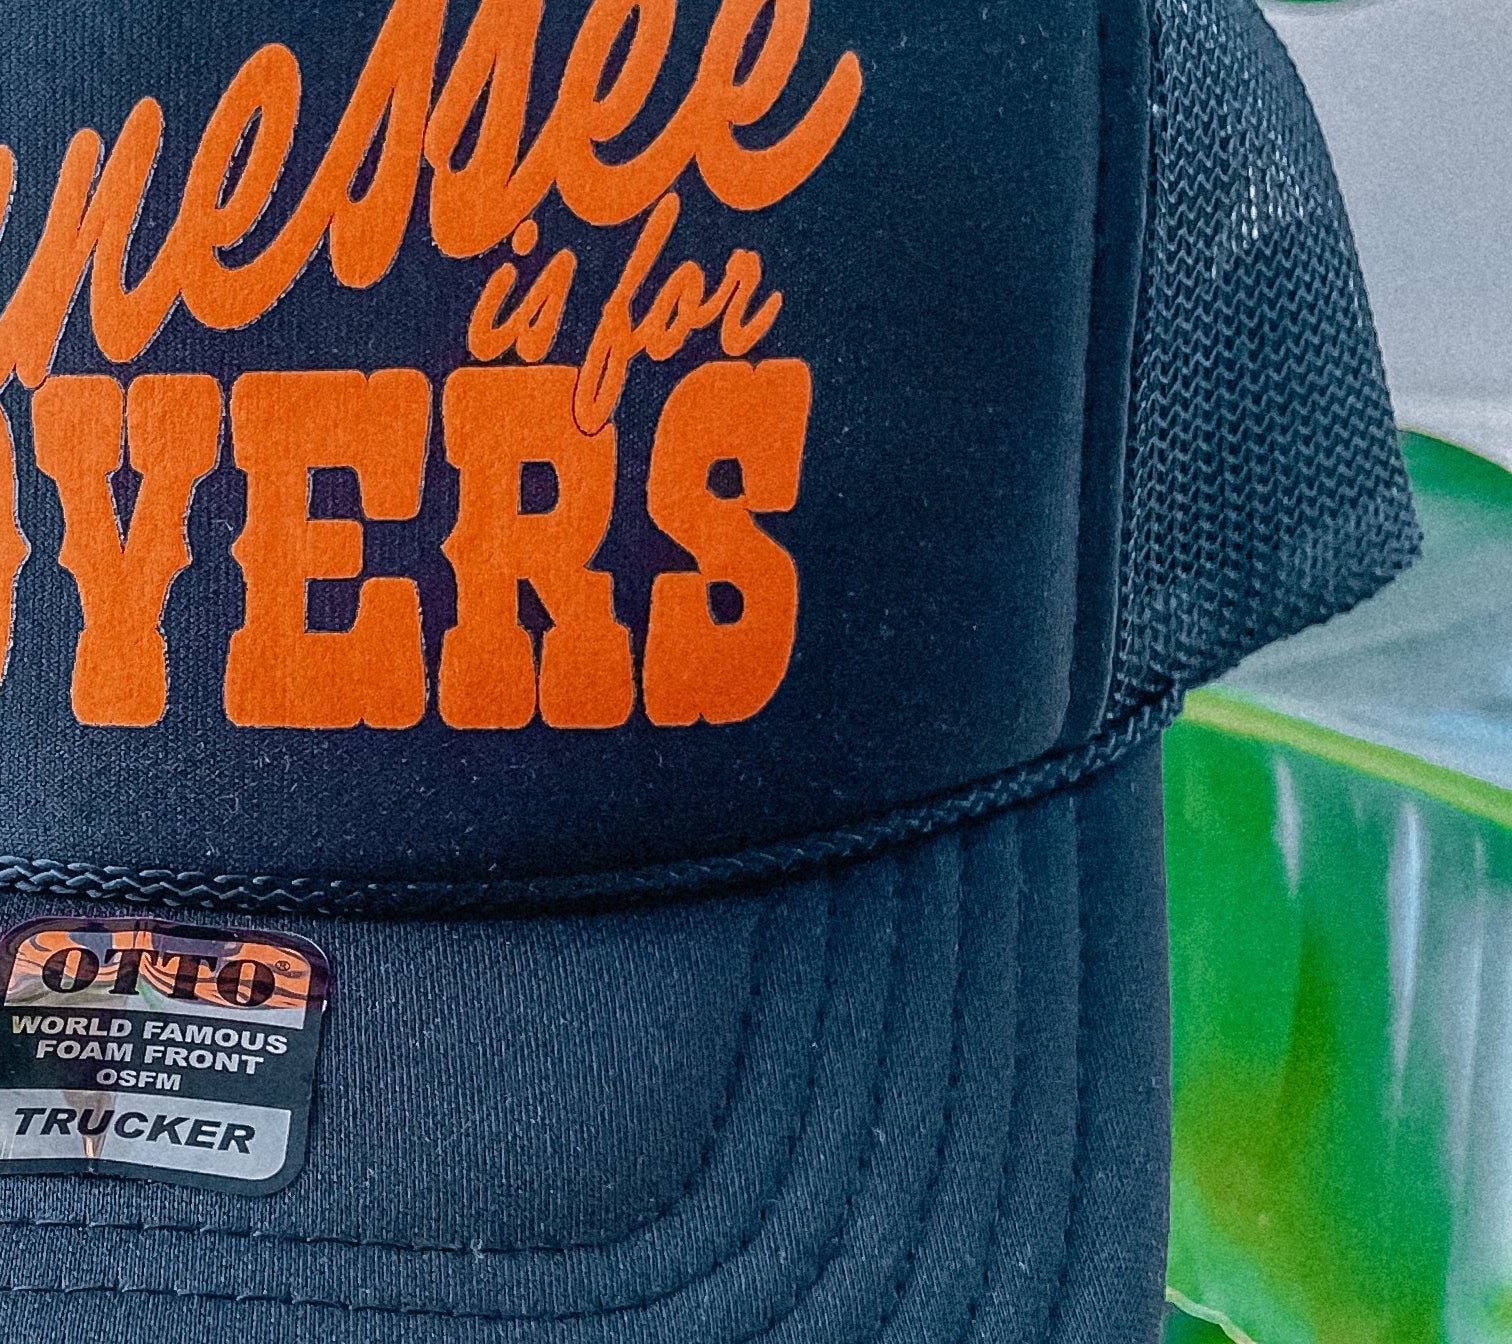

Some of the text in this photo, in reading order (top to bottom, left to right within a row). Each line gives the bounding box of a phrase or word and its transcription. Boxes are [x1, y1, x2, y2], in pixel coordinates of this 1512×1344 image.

[468, 192, 783, 437] is for
[11, 1015, 288, 1054] WORLD FAMOUS
[35, 1040, 264, 1074] FOAM FRONT
[96, 1068, 181, 1091] OSFM
[14, 1107, 256, 1155] TRUCKER
